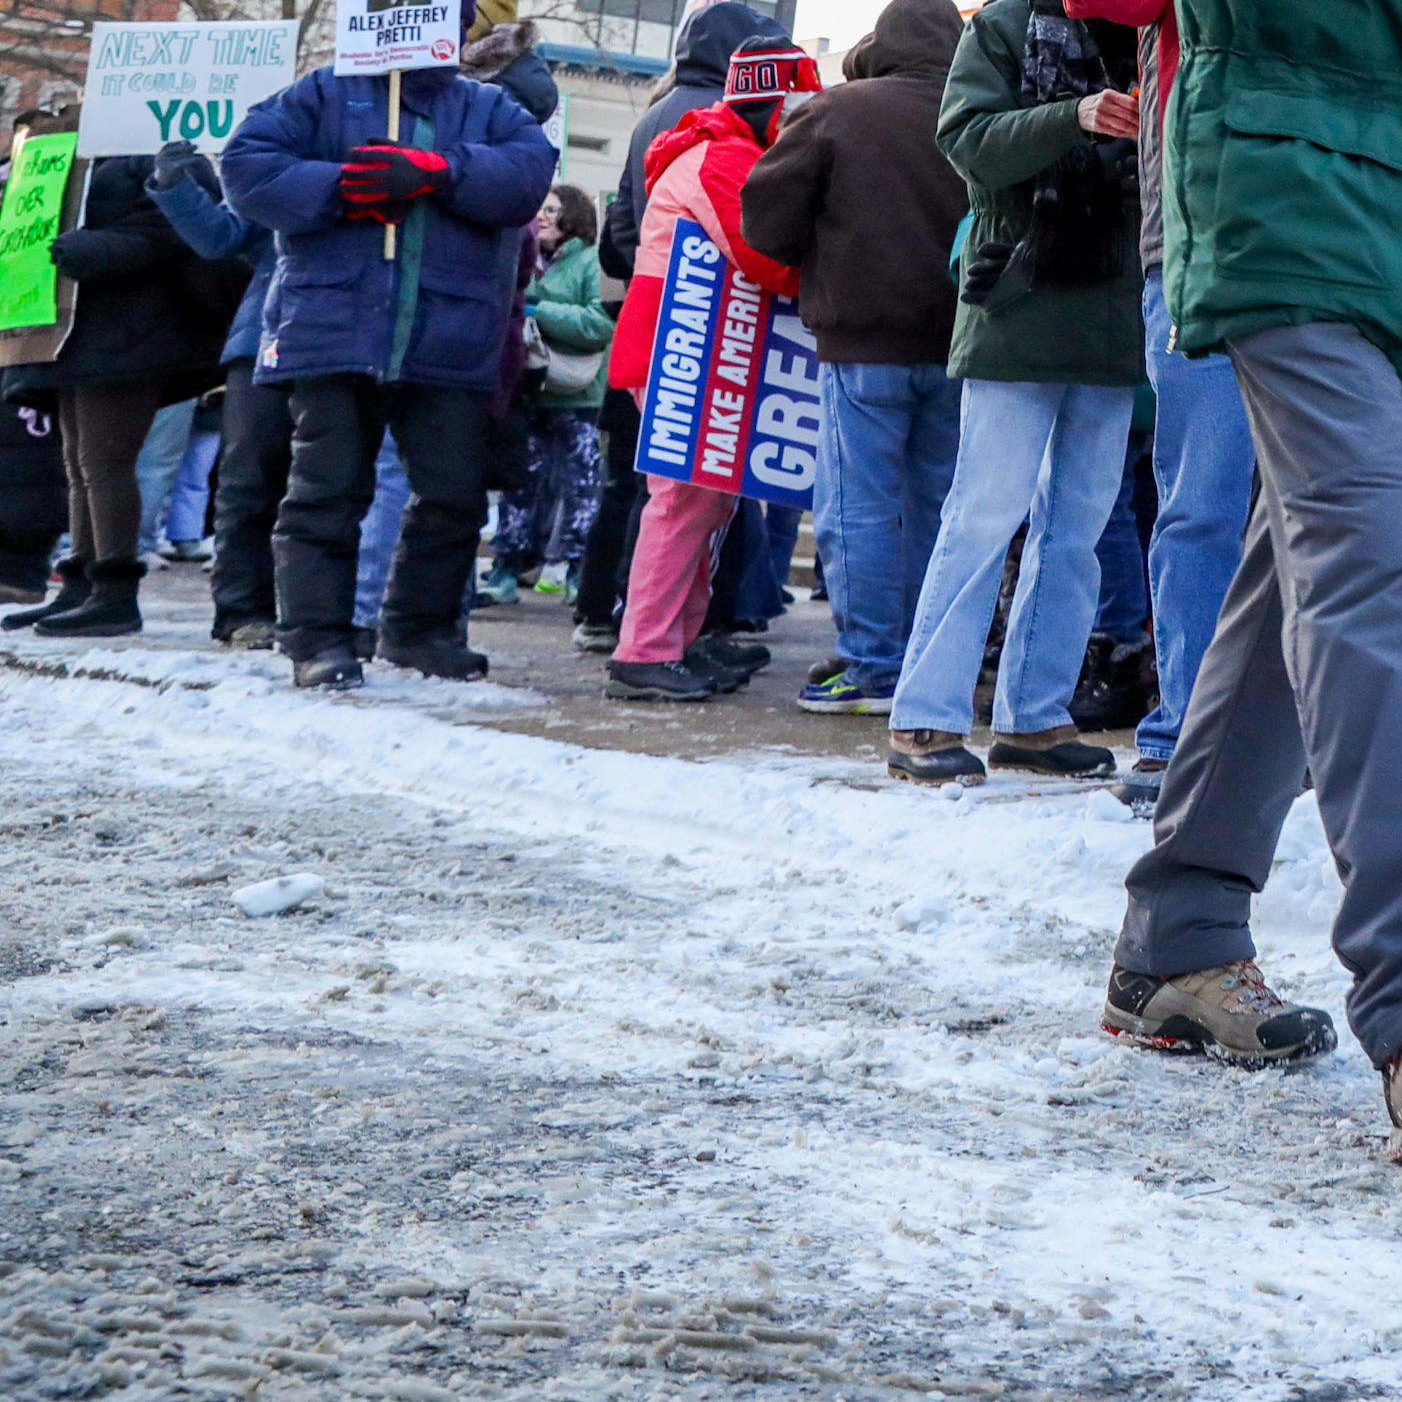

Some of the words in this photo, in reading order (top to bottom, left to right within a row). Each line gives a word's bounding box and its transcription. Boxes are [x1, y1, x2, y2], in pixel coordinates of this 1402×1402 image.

[348, 14, 385, 32] ALEX
[388, 6, 448, 27] JEFFREY
[376, 26, 421, 47] PRETTI
[96, 30, 200, 69] NEXT
[208, 28, 288, 67] TIME,
[101, 74, 125, 96] IT
[128, 72, 196, 94] COULD
[208, 73, 239, 94] BE
[146, 99, 233, 141] YOU
[648, 235, 721, 466] IMMIGRANTS
[701, 389, 745, 478] MAKE
